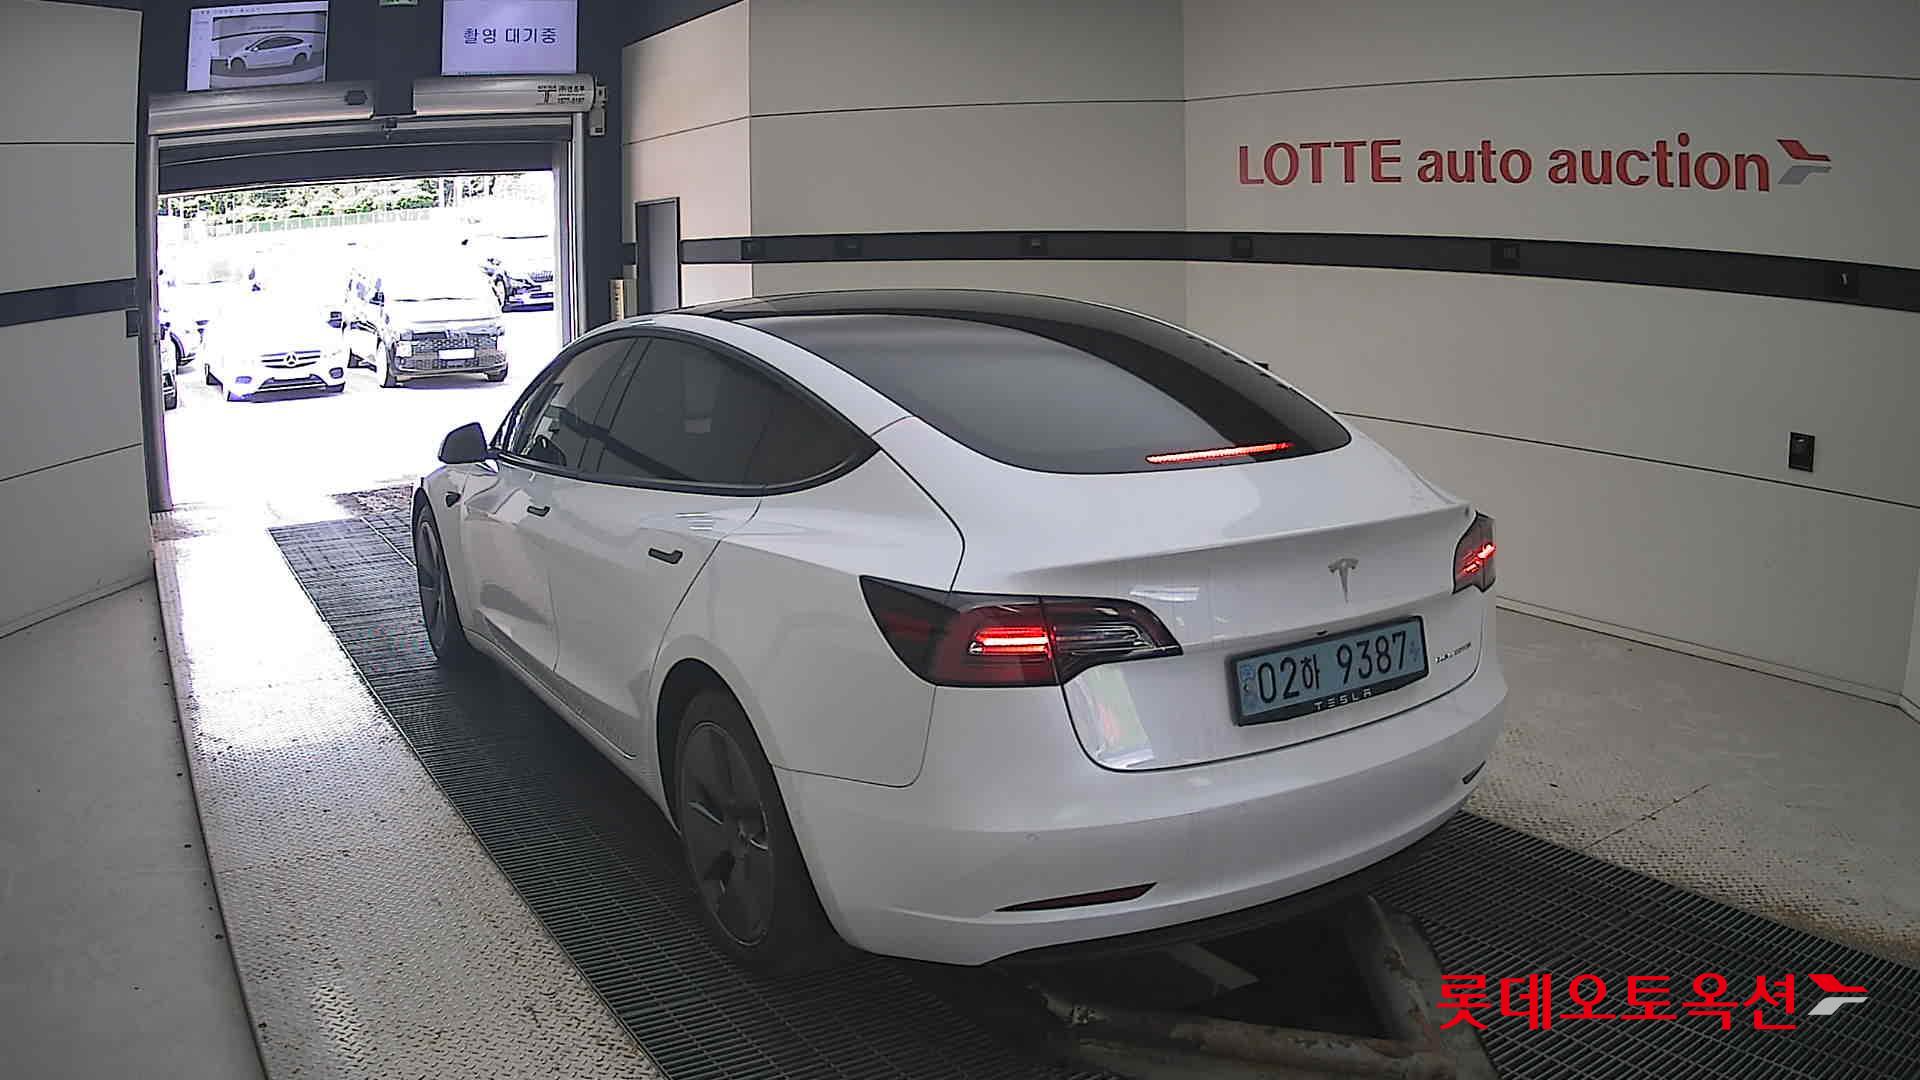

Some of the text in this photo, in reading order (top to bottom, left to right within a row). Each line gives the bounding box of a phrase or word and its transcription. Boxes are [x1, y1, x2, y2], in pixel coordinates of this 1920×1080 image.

[505, 27, 557, 45] 대기중
[1239, 132, 1770, 192] LOTTE auto auction
[1257, 653, 1321, 704] 02하
[1336, 630, 1407, 685] 9387
[1313, 688, 1373, 713] TESLA
